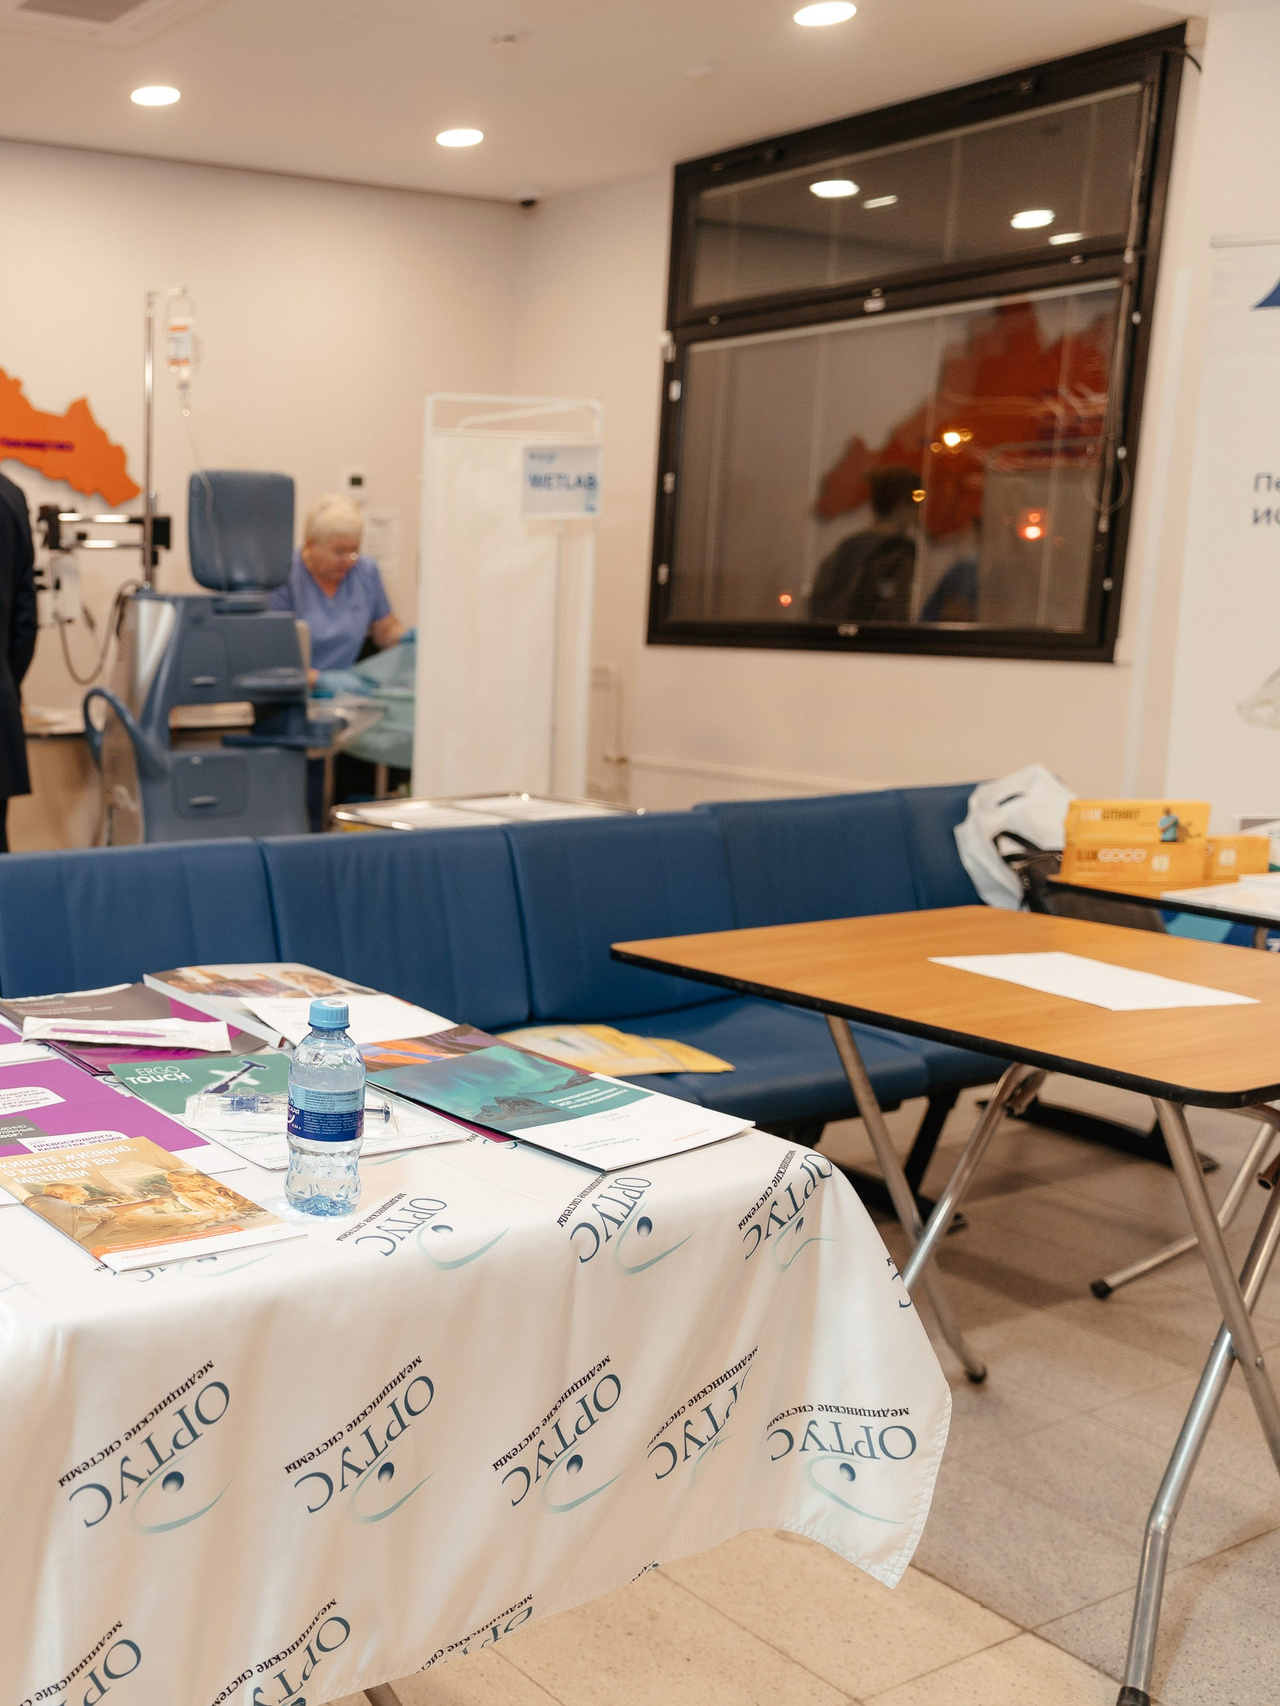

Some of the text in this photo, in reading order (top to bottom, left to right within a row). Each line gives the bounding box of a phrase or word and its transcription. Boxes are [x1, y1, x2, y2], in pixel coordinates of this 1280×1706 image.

[125, 1072, 191, 1085] TOUCH
[135, 1065, 181, 1077] ERGO
[3, 1157, 120, 1178] О КОТОРОЙ ВЫ
[13, 1169, 91, 1185] МЕЧТАЛИ
[62, 1145, 138, 1162] ЖИЗНЬЮ,
[355, 1197, 447, 1257] ОРТУС
[570, 1177, 651, 1263] ОРТУС
[738, 1187, 774, 1231] системы
[742, 1153, 833, 1260] ОРТУС
[57, 1360, 215, 1488] медицинские системы
[68, 1381, 230, 1528] ОРТУС
[284, 1356, 423, 1475] медицинские системы
[293, 1374, 435, 1514] ОРТУС
[492, 1355, 612, 1473] медицинские системы
[501, 1372, 623, 1507] ОРТУС
[766, 1403, 911, 1432] медицинские системы
[770, 1423, 917, 1462] ОРТУС
[35, 1620, 124, 1701] медицинские
[211, 1598, 337, 1706] медицинские систем
[252, 1616, 351, 1706] ОРТУ
